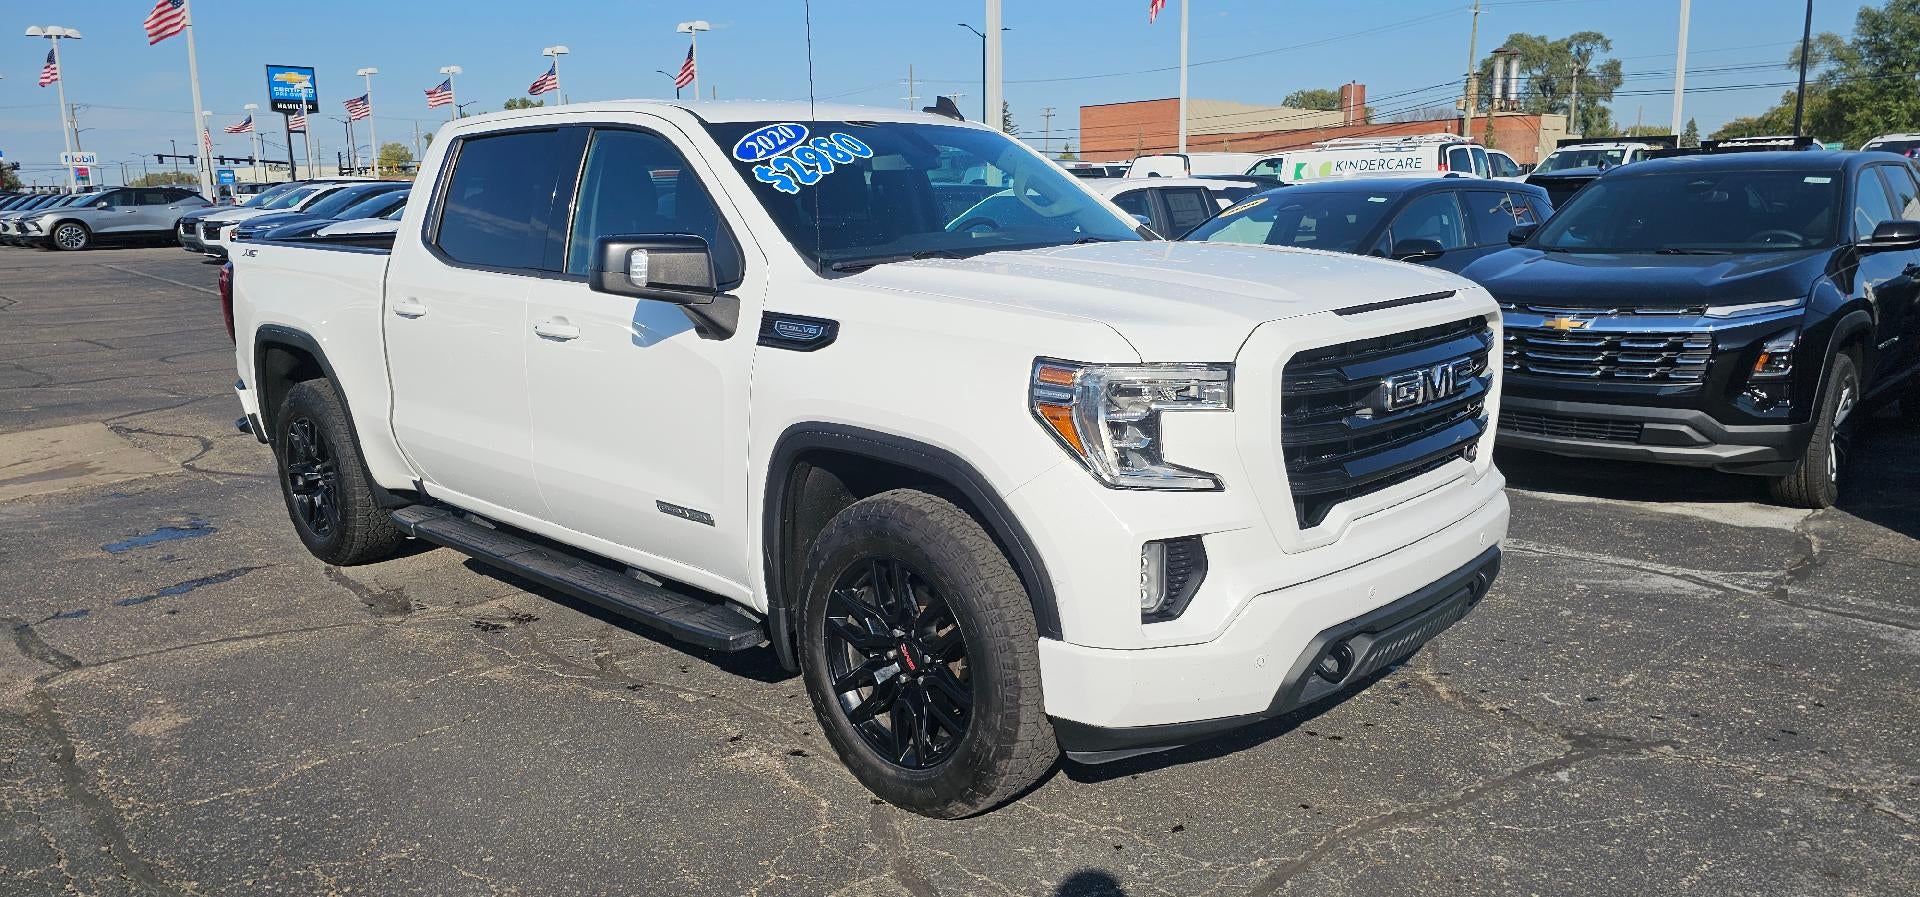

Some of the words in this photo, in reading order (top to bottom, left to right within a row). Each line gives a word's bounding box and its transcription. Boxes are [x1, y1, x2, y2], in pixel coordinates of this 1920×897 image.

[273, 86, 314, 94] CERTIFED
[745, 125, 796, 158] 2020
[64, 154, 95, 163] Mobil
[752, 132, 874, 195] $2980
[1335, 157, 1423, 172] KINDERCARE
[1384, 356, 1480, 412] GMC
